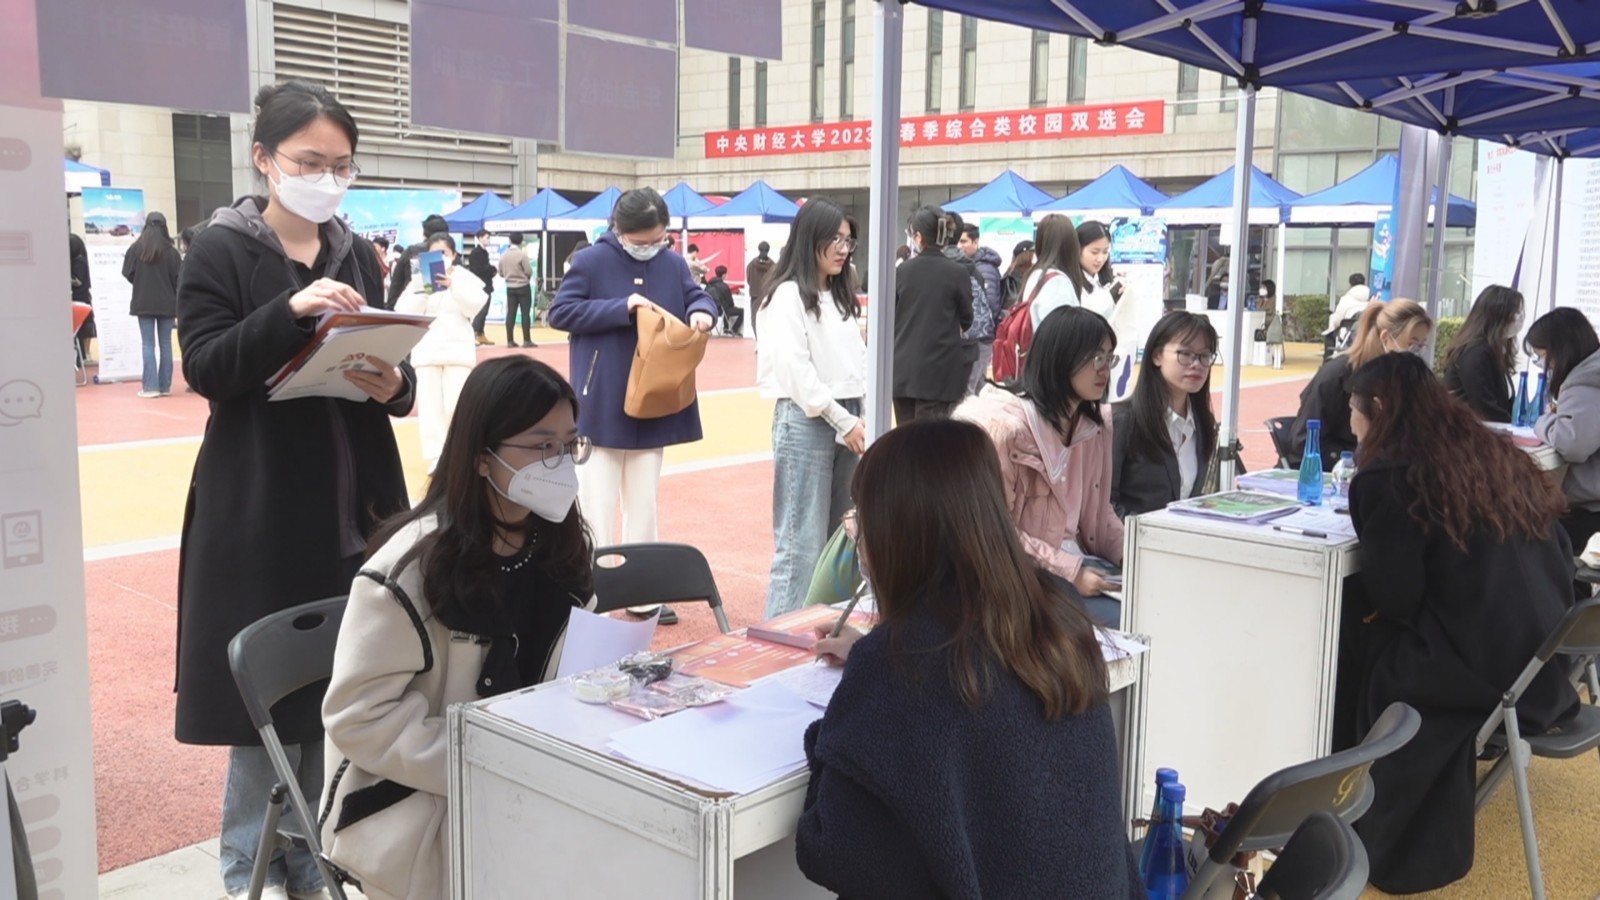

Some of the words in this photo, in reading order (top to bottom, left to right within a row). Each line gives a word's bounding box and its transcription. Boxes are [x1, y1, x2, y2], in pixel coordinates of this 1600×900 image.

[716, 106, 1147, 153] 中央财经大学2023春季综合类校园双选会
